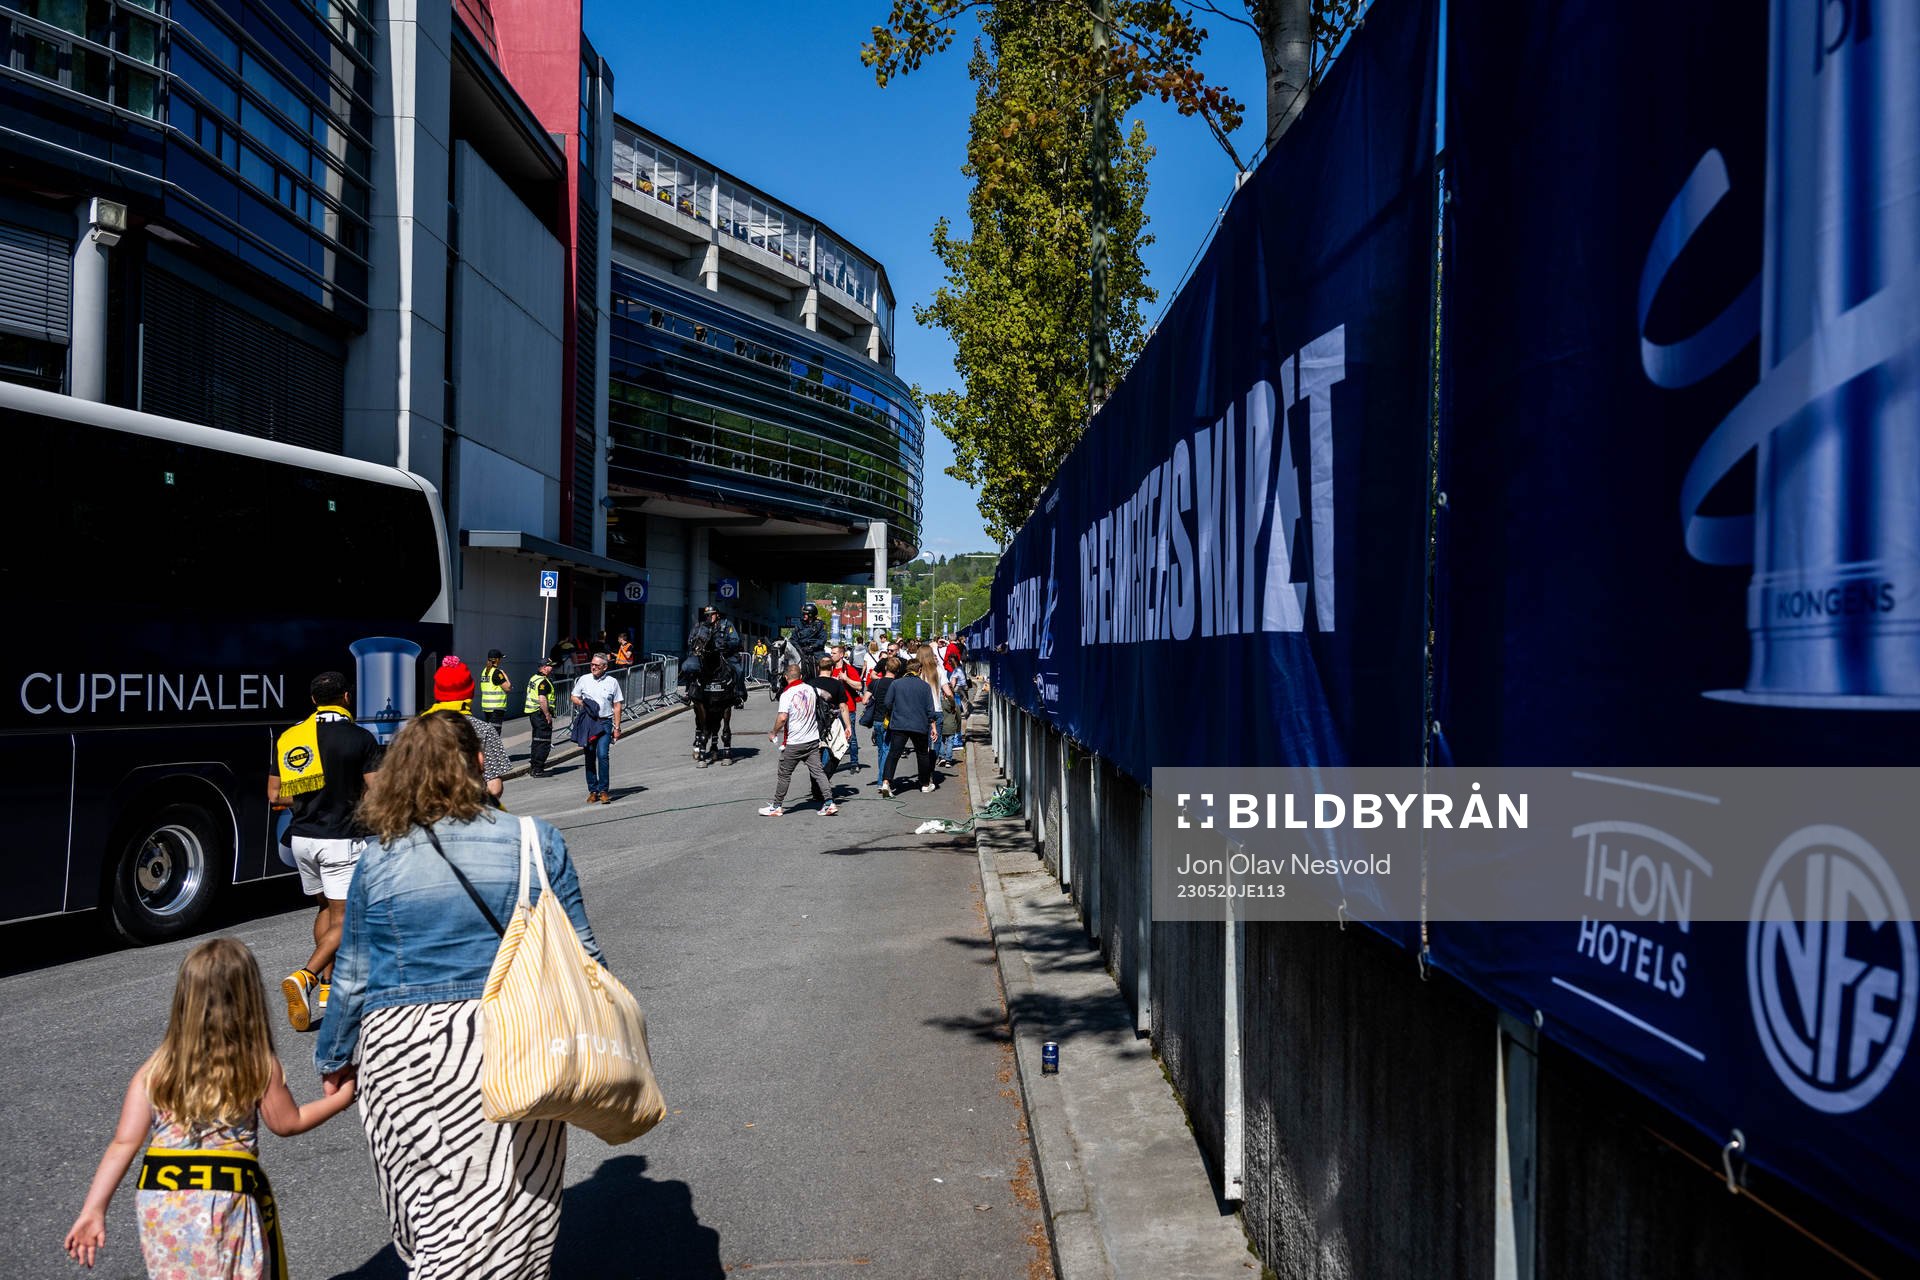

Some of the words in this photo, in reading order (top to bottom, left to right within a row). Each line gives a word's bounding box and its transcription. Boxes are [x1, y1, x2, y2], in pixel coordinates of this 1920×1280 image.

[545, 578, 553, 587] 18
[626, 586, 641, 598] 18
[722, 586, 732, 595] 17
[1776, 582, 1896, 618] KONGENS
[20, 672, 285, 715] CUPFINALEN
[1572, 820, 1713, 934] THON
[1577, 915, 1688, 998] HOTELS
[1761, 852, 1901, 1084] NFF
